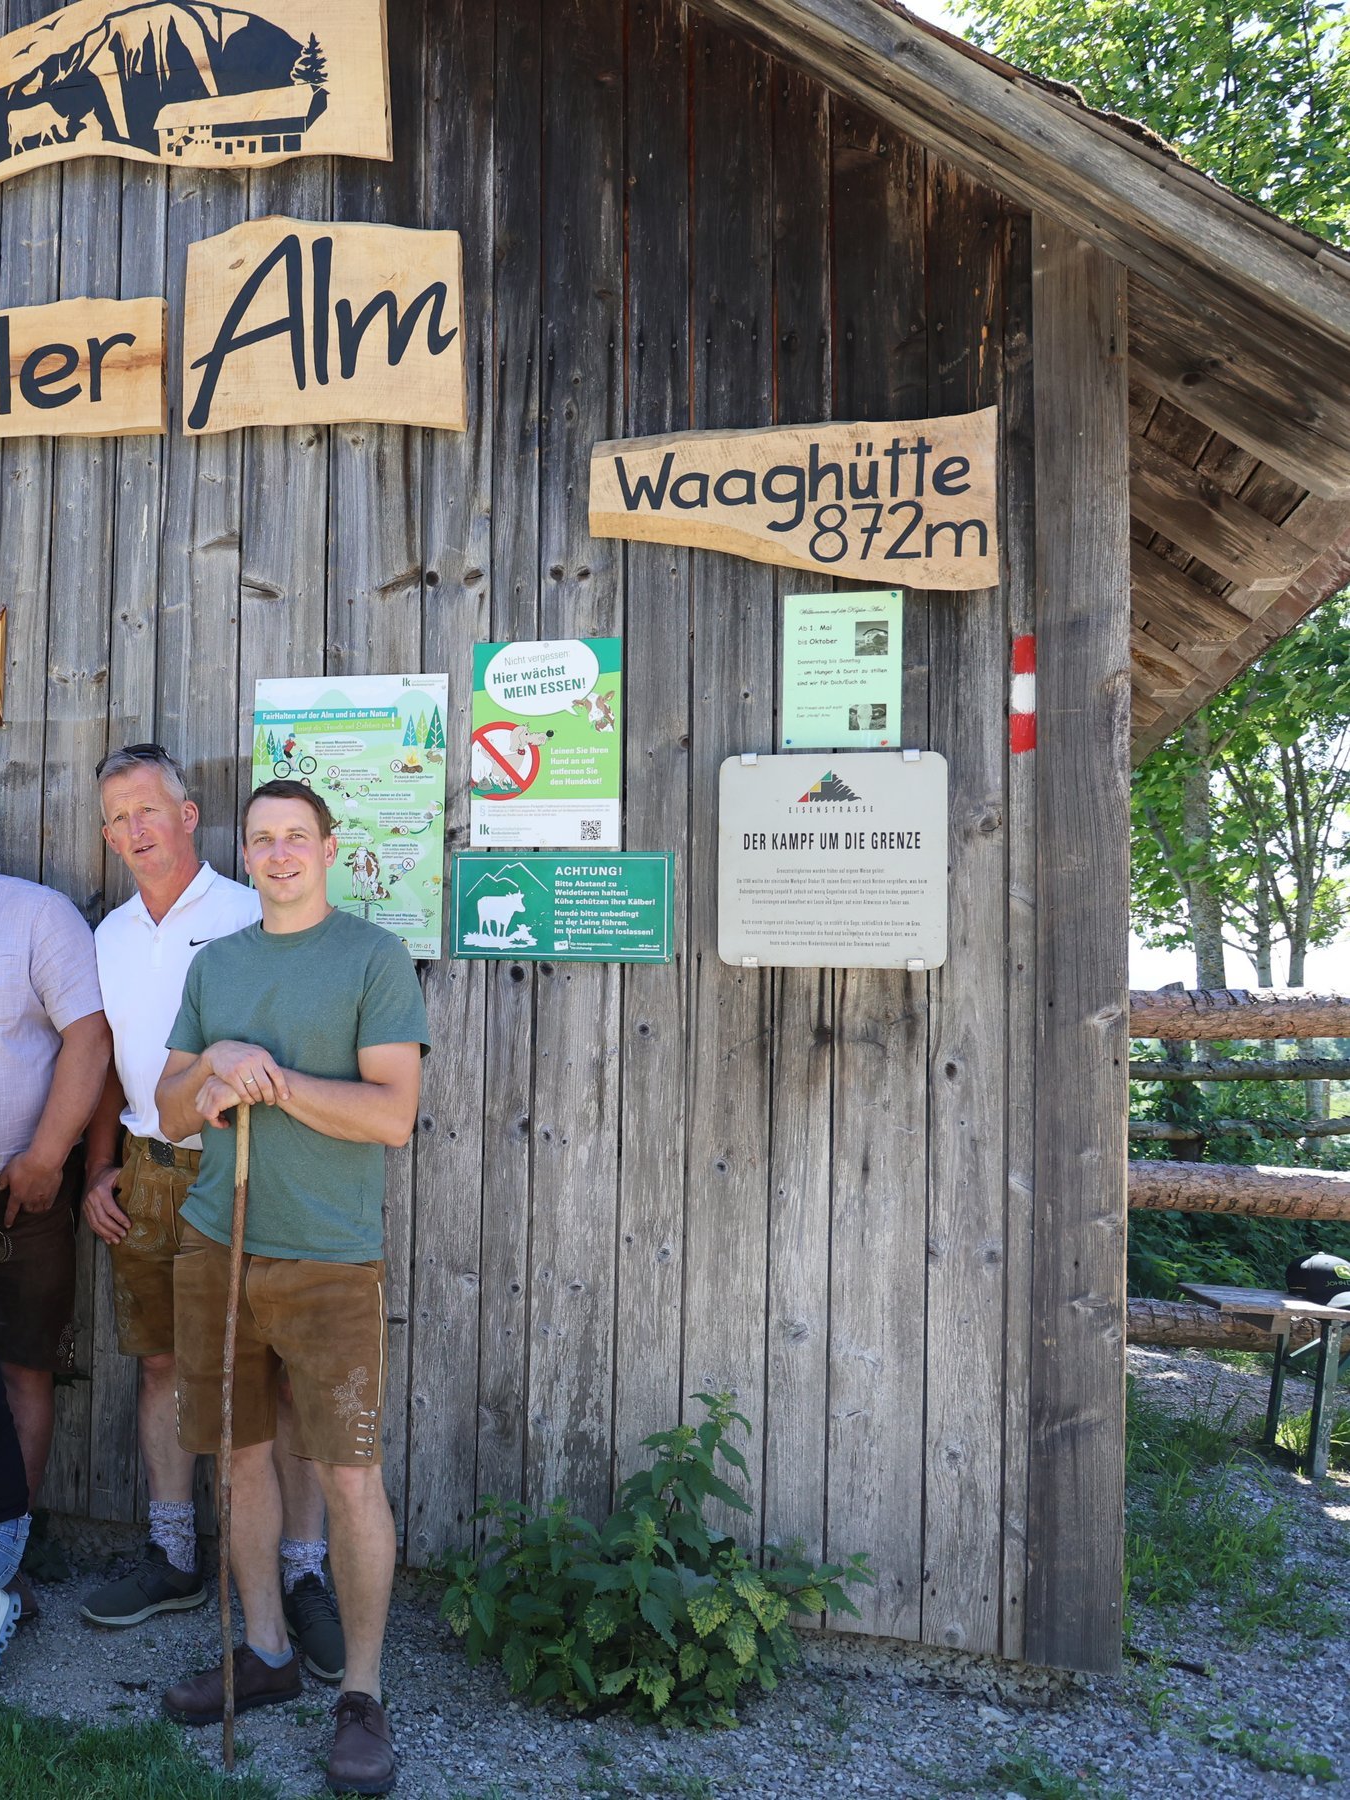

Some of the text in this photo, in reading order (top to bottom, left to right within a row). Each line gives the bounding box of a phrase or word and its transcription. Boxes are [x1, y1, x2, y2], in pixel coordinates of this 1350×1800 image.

[187, 234, 458, 431] Alm
[614, 436, 971, 532] Waaghütte
[809, 500, 988, 563] 872m
[505, 650, 571, 666] Nicht vergessen:
[493, 665, 566, 685] Hier wächst
[504, 678, 586, 699] MEIN ESSEN!
[309, 711, 320, 719] der
[357, 710, 369, 718] der
[551, 747, 575, 755] Leinen
[590, 746, 609, 754] Ihren
[551, 757, 569, 765] Hund
[789, 805, 874, 814] EISENSTRASSE
[744, 832, 921, 851] DER KAMPF UM DIE GRENZE
[555, 866, 622, 876] ACHTUNG!
[628, 898, 655, 906] Kälber!
[600, 910, 639, 918] unbedingt
[615, 928, 654, 936] loslassen!
